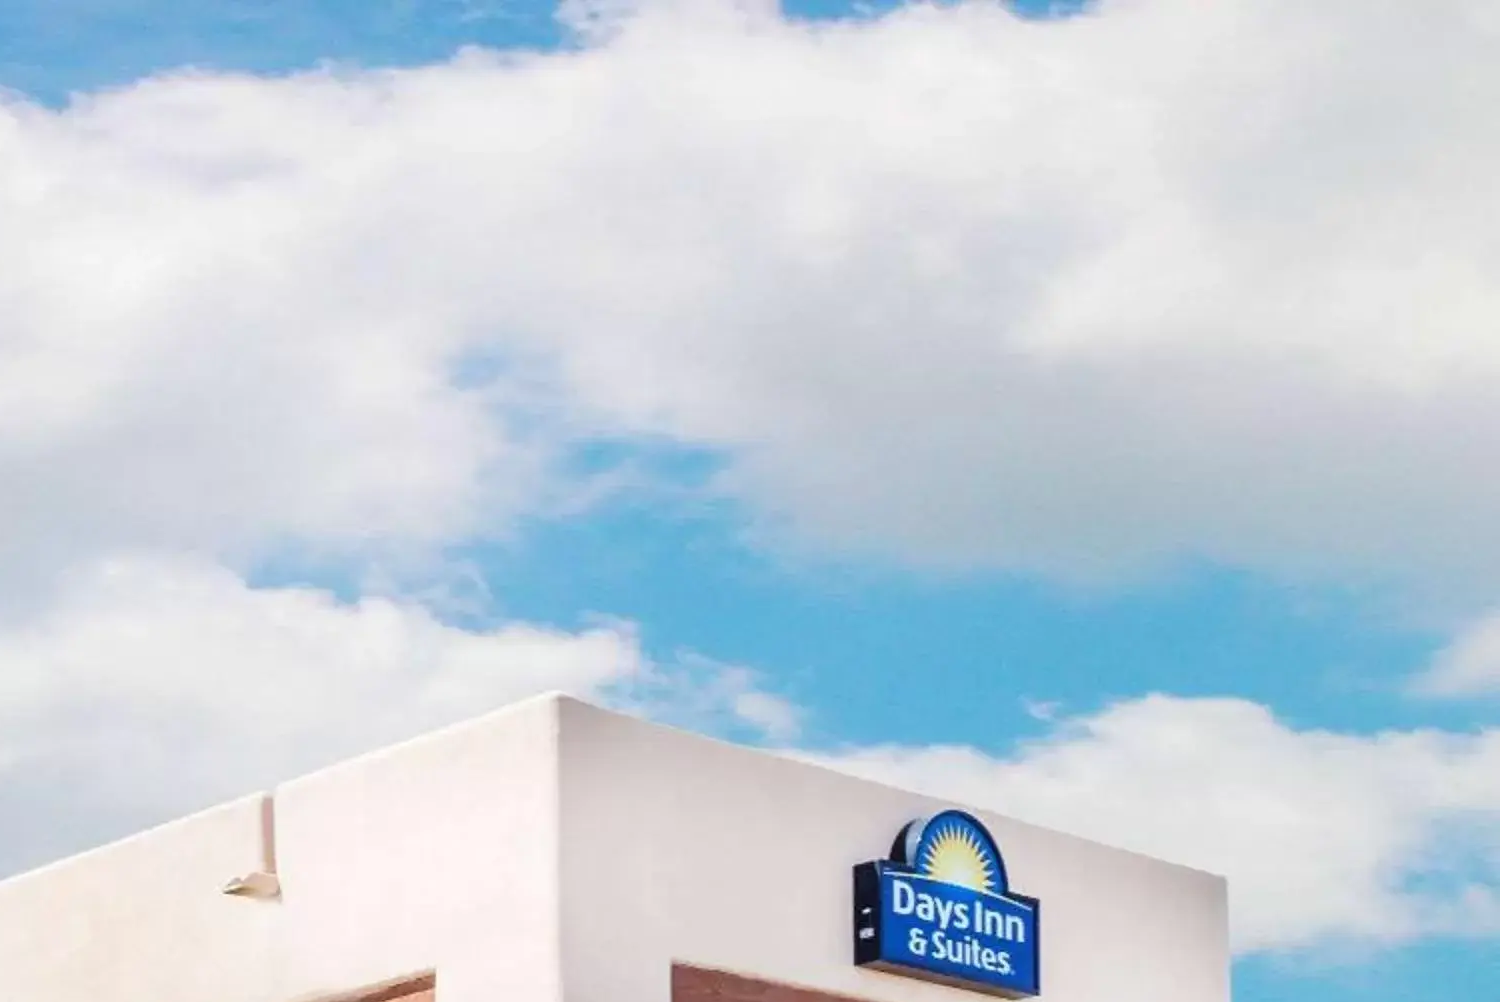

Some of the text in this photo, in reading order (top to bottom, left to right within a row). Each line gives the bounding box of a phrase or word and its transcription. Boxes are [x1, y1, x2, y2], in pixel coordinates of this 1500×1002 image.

[893, 880, 1025, 942] Days Inn
[908, 928, 1012, 975] & Suites
